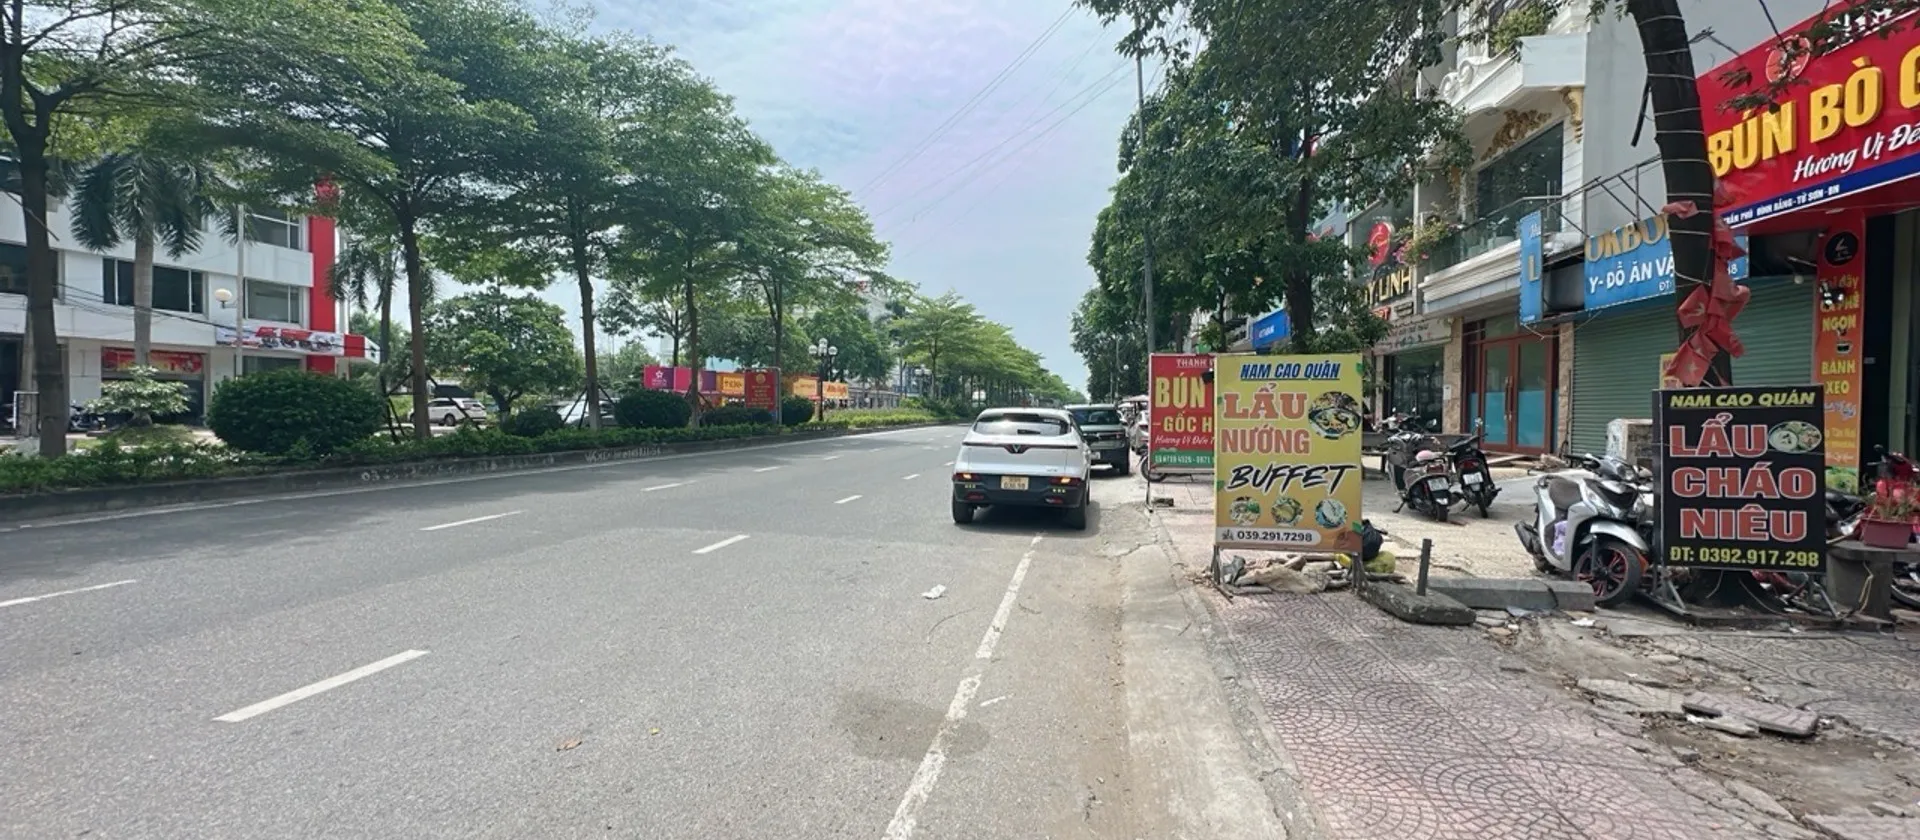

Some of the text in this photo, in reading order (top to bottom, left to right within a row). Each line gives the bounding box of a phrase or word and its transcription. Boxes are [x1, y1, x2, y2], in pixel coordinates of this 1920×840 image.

[1708, 100, 1796, 177] BÚN
[1810, 56, 1882, 143] BÒ
[1793, 149, 1859, 182] Hương
[1863, 132, 1886, 160] Vị
[1629, 261, 1652, 283] ĂN
[1240, 360, 1340, 379] NAM CAO QUÁN
[1154, 371, 1206, 408] BÚN
[1222, 383, 1308, 421] LẨU
[1670, 389, 1816, 408] NAM CAO QUÁN
[1163, 410, 1197, 433] GỐC
[1669, 412, 1769, 458] LẨU
[1221, 423, 1312, 454] NƯỚNG
[1227, 463, 1358, 495] BUFFET
[1672, 461, 1817, 500] CHÁO
[1237, 529, 1313, 543] 039.291.7298
[1680, 503, 1808, 543] NIÊU
[1670, 547, 1820, 567] ĐT: 0392.917.298
